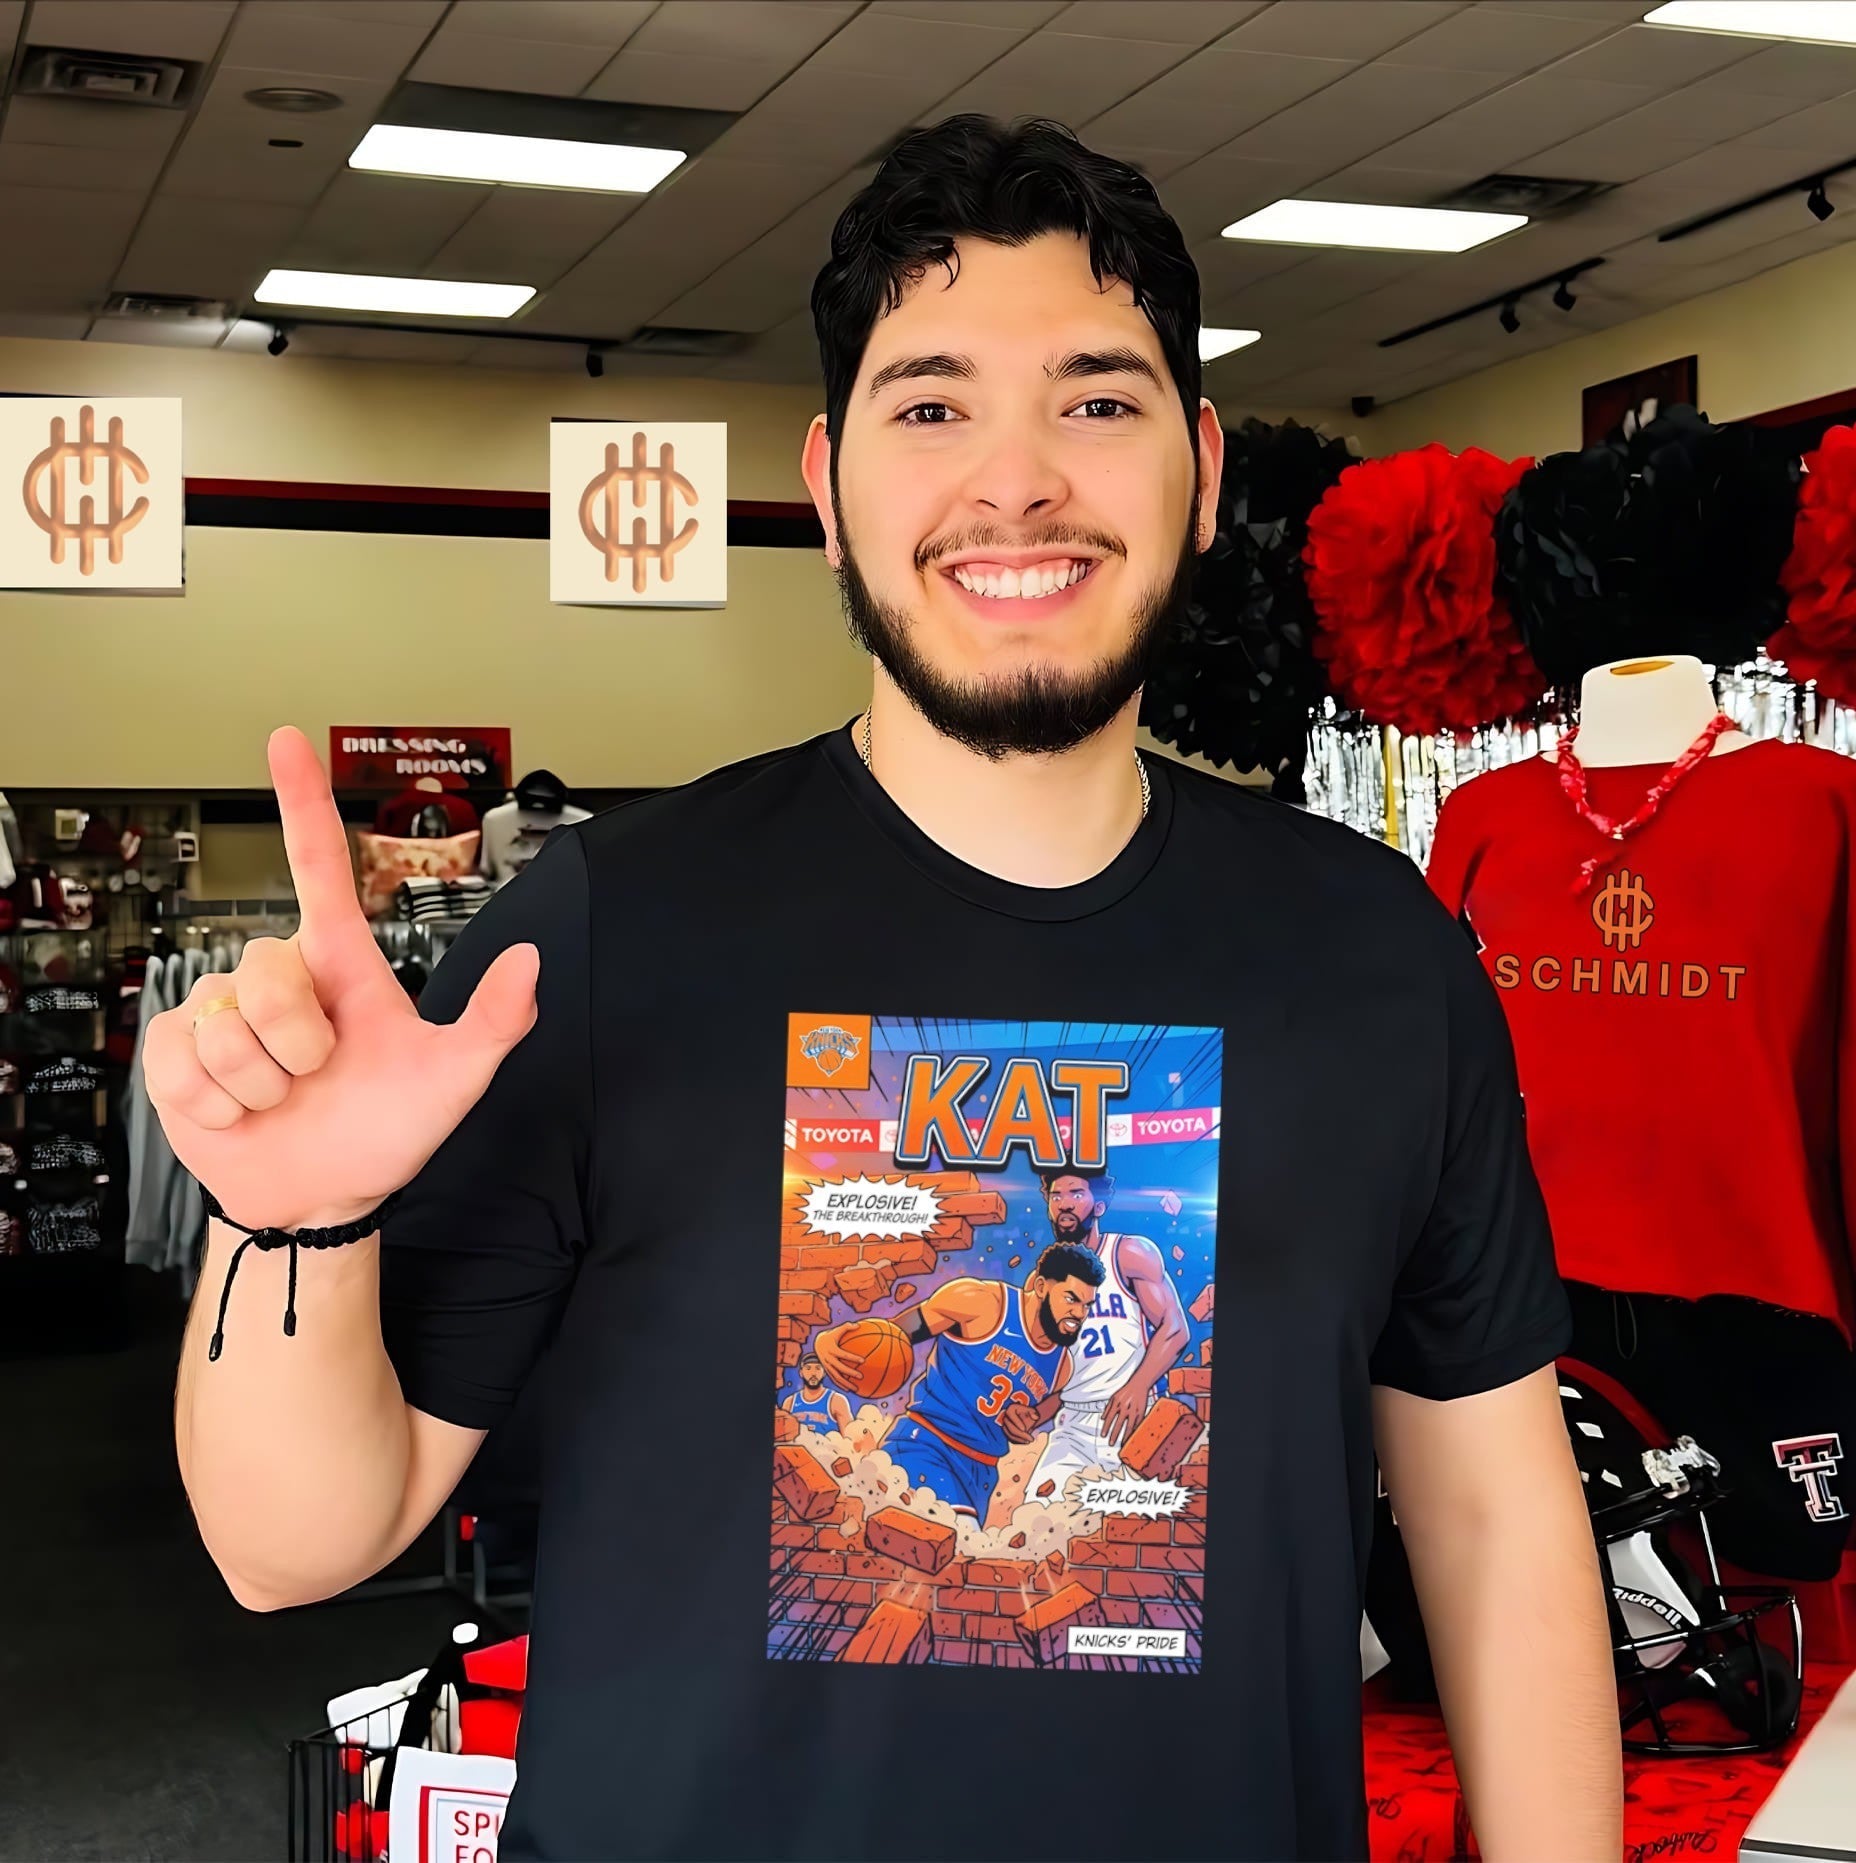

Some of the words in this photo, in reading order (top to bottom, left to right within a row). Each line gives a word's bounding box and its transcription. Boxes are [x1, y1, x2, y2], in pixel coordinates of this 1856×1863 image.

[396, 758, 487, 774] ROOMS
[1494, 954, 1747, 1001] SCHMIDT
[896, 1054, 1129, 1169] KAT
[802, 1127, 873, 1143] TOYOTA
[1137, 1116, 1206, 1136] TOYOTA
[827, 1193, 918, 1211] EXPLOSIVE!
[813, 1210, 836, 1221] THE
[836, 1211, 929, 1224] BREAKTHROUGH!
[1081, 1324, 1115, 1359] 21
[984, 1343, 1026, 1376] NEW
[1020, 1363, 1049, 1403] YORK
[1086, 1488, 1181, 1506] EXPLOSIVE!
[1074, 1634, 1132, 1648] KNICKS'
[1136, 1635, 1179, 1650] PRIDE
